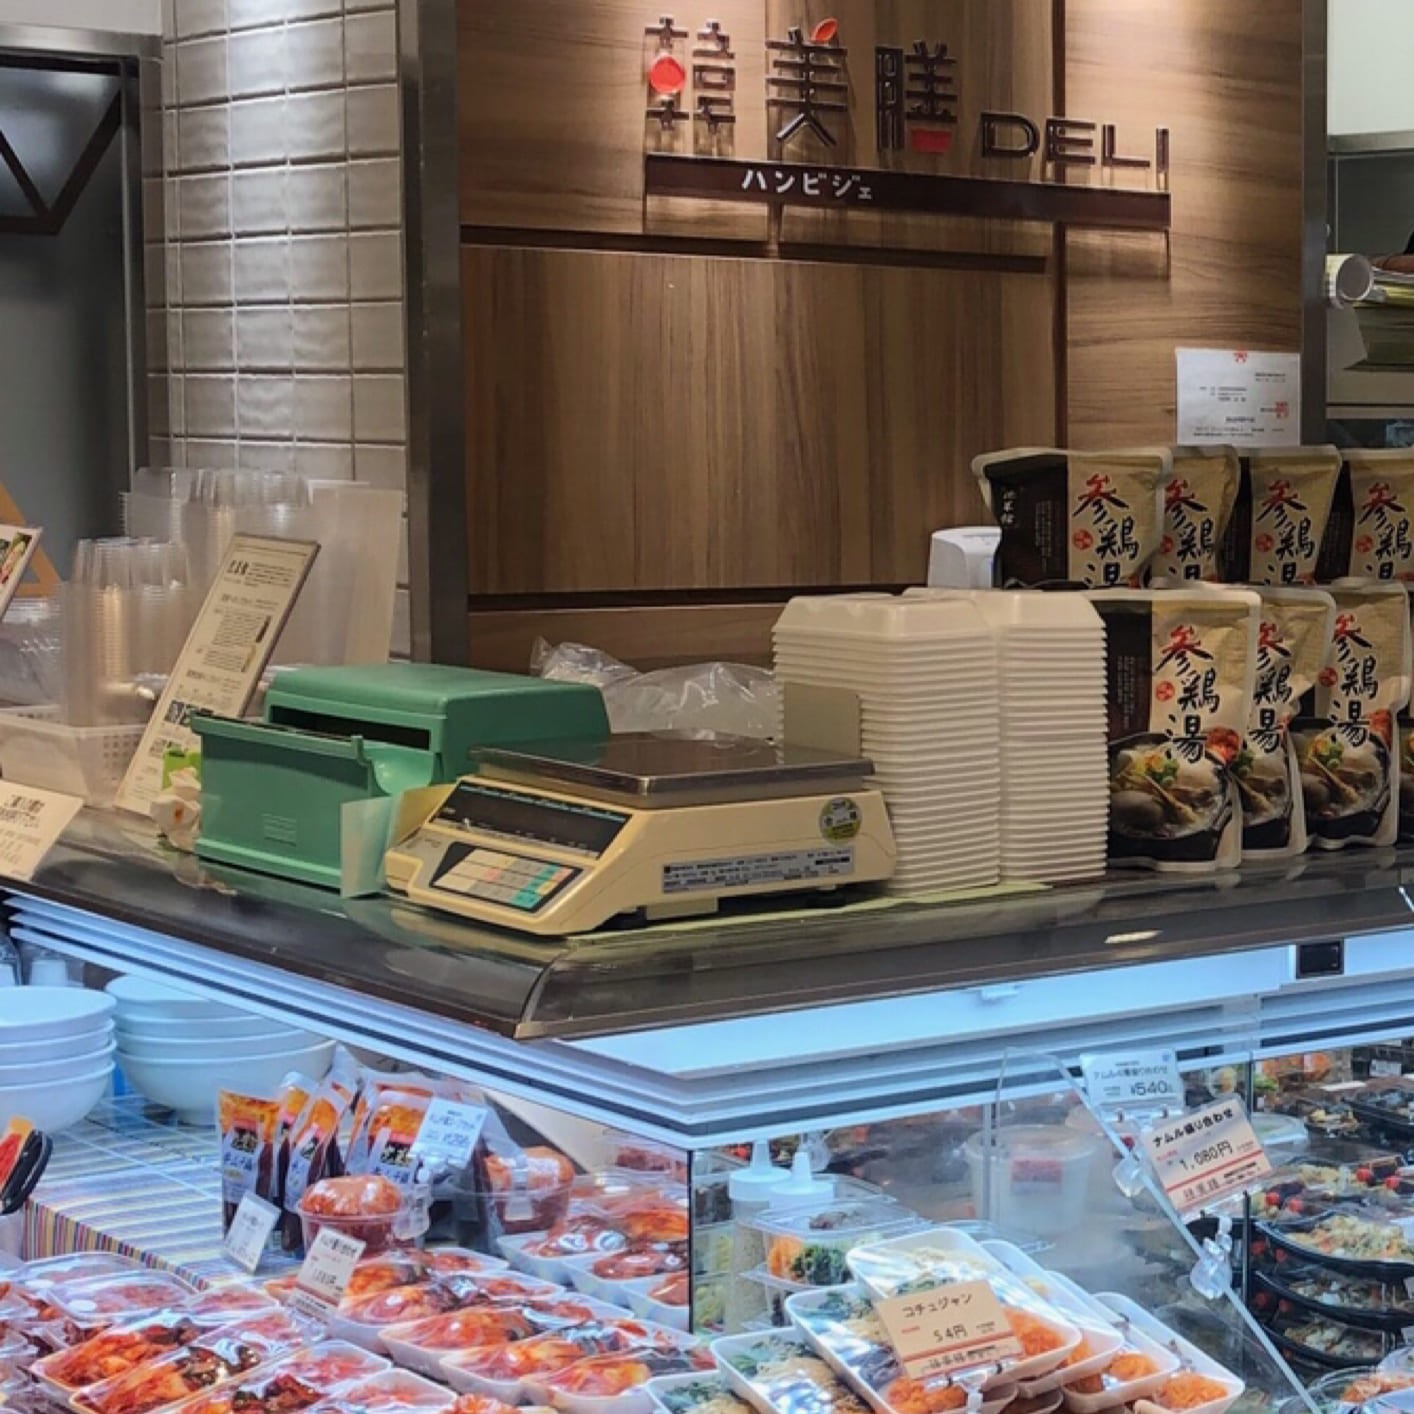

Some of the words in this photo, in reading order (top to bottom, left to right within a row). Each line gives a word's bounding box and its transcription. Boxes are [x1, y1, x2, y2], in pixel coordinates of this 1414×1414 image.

[981, 111, 1169, 173] DELI
[742, 168, 872, 199] ハンビジェ
[1155, 624, 1220, 763] 参鶏湯
[1152, 1108, 1233, 1148] ナムル盛り合わせ
[902, 1293, 972, 1318] コチュジャン
